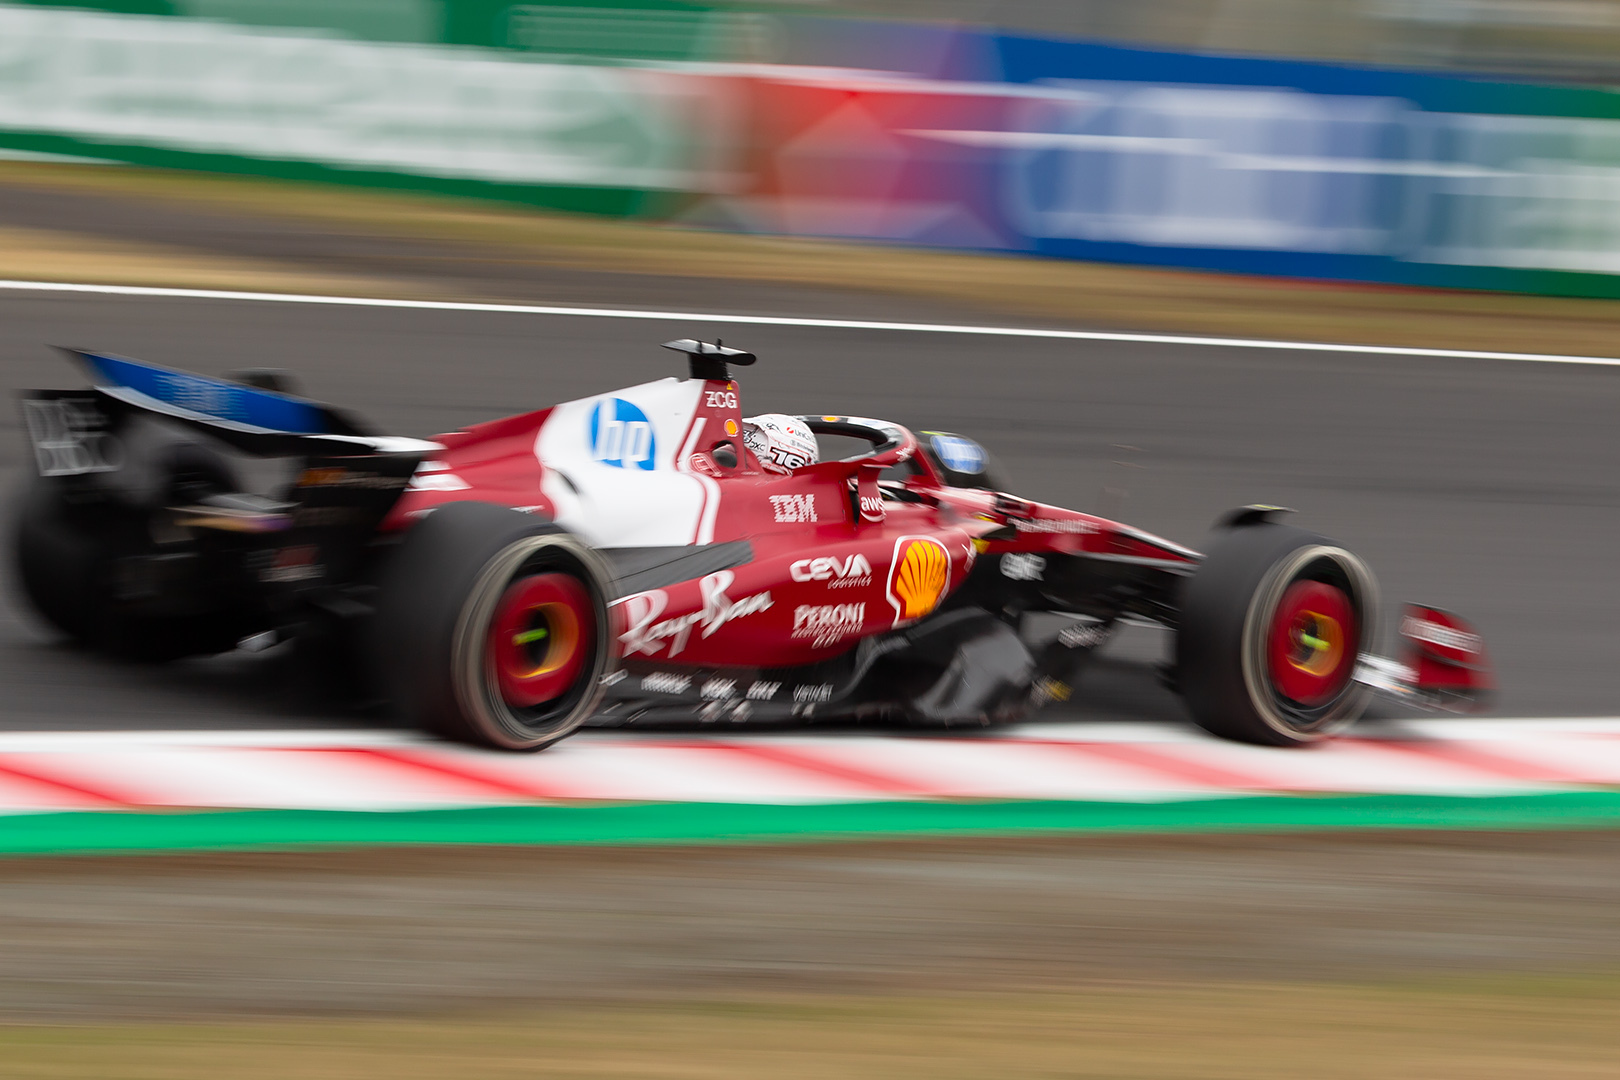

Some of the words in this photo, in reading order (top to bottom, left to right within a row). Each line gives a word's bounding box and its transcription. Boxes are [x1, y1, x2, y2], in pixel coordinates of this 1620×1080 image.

[594, 398, 652, 470] hp
[770, 446, 806, 470] 16
[769, 494, 818, 522] IBM
[789, 553, 873, 582] CEVA
[607, 569, 776, 659] Ray-Ban
[793, 602, 866, 630] PERONI
